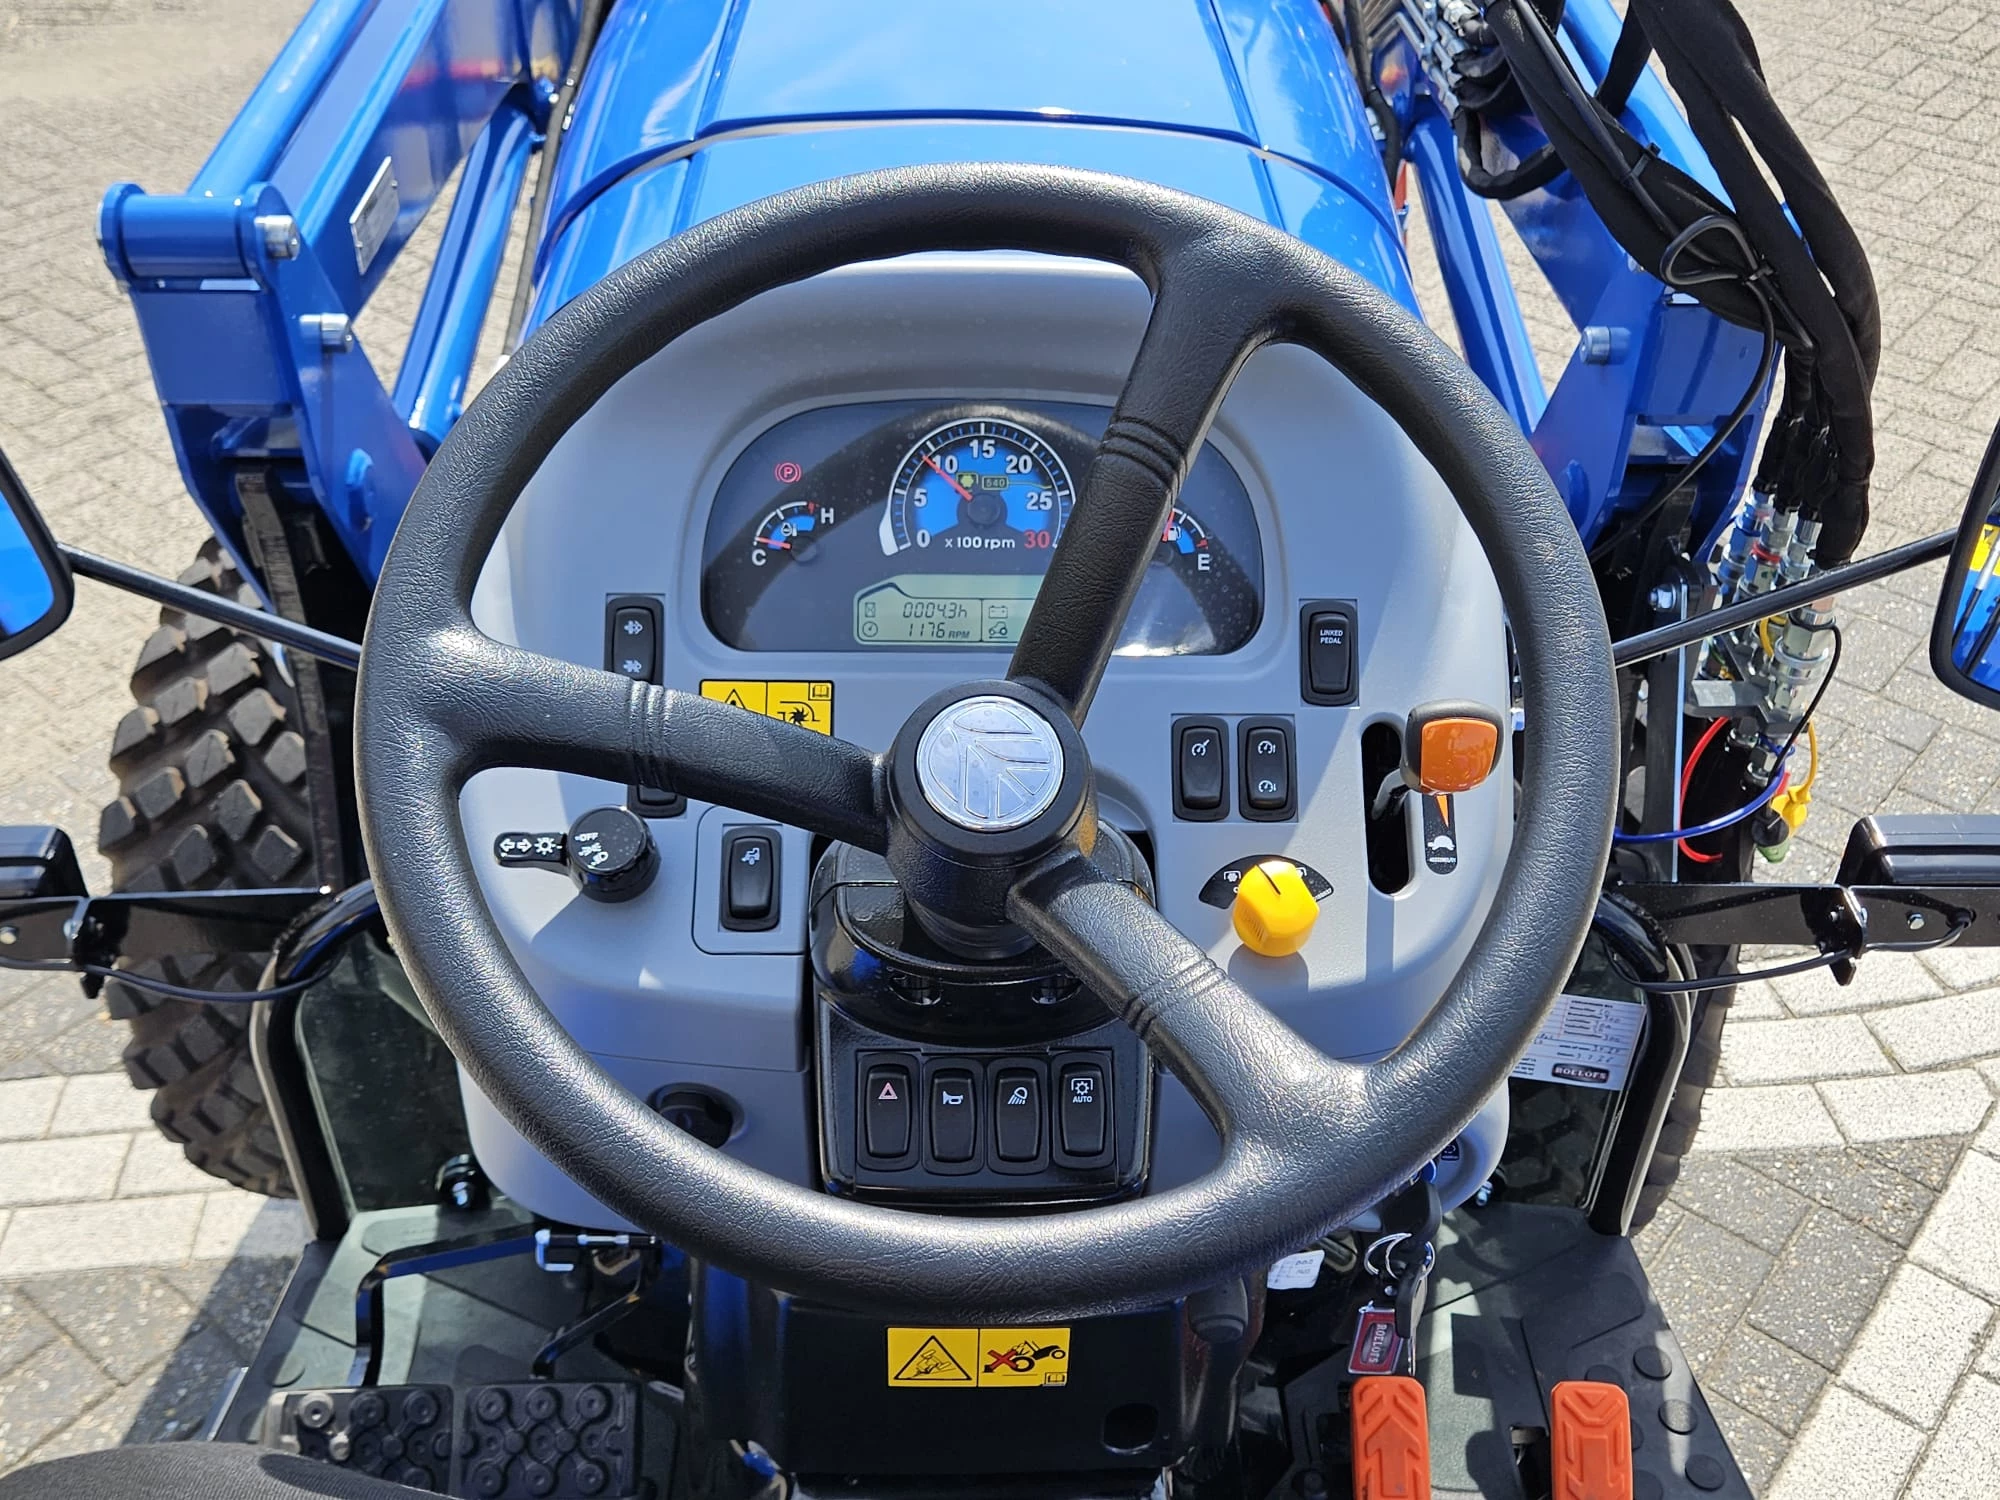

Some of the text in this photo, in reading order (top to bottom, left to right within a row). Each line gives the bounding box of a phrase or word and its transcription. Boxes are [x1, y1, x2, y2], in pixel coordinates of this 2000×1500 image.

[969, 439, 995, 459] 15
[933, 455, 958, 474] 10
[1005, 455, 1033, 474] 20
[986, 478, 1005, 488] 540
[914, 488, 927, 507] 5
[1026, 492, 1052, 510] 25
[820, 507, 834, 524] H
[916, 530, 930, 547] 0
[945, 537, 1015, 551] x 100 rpm
[1024, 531, 1050, 548] 30
[751, 549, 766, 566] C
[1198, 554, 1210, 570] E
[908, 622, 970, 639] 1176 RPM
[580, 832, 599, 842] OFF
